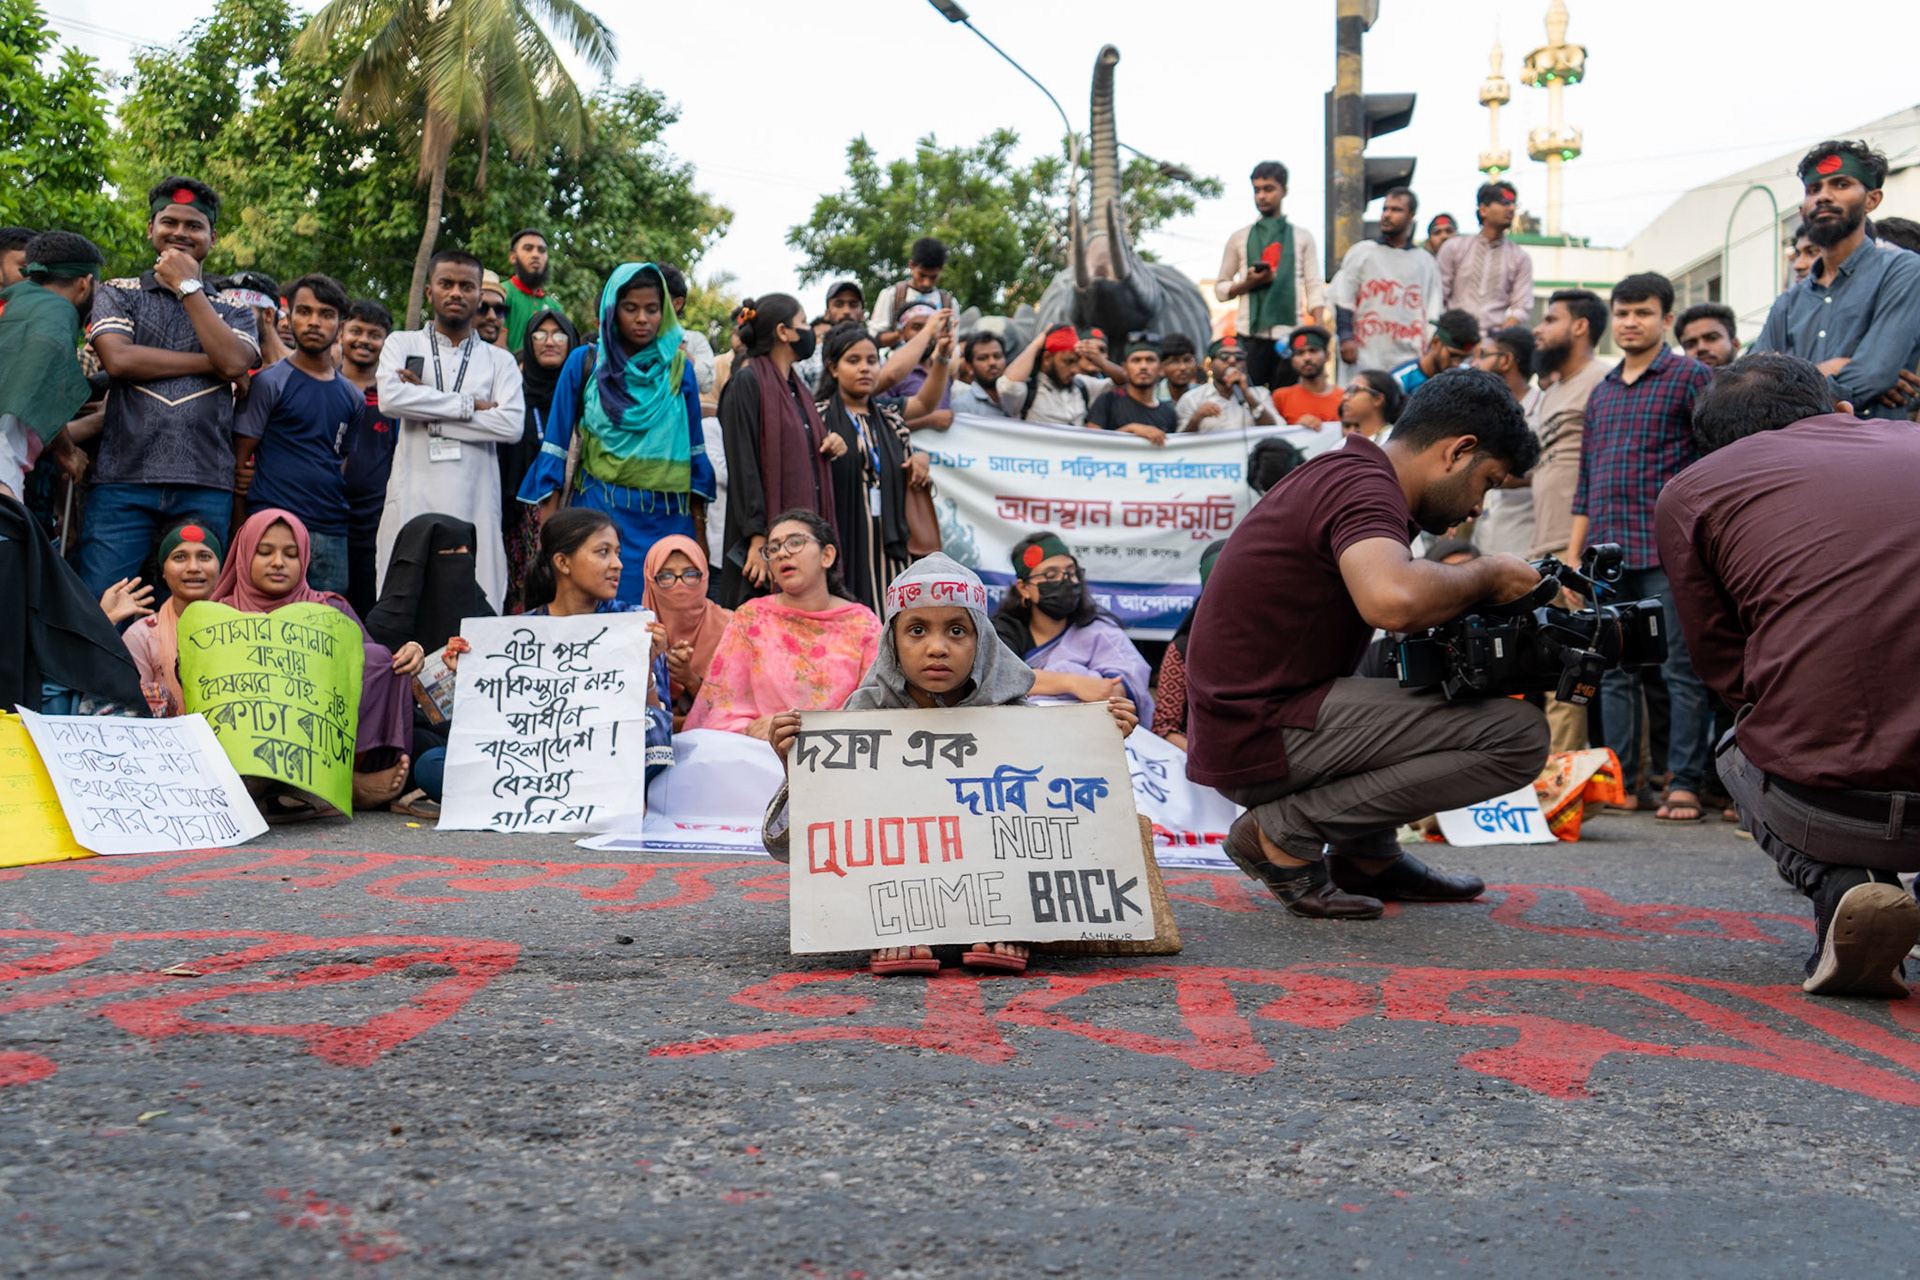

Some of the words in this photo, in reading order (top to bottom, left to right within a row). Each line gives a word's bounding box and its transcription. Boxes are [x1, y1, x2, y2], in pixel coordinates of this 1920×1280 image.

[925, 449, 977, 469] ০১৮
[988, 455, 1049, 479] সালের
[1061, 456, 1127, 481] পরিপত্র
[1138, 457, 1241, 484] পুনর্বহালের
[995, 494, 1112, 530] অবস্থান
[1121, 492, 1236, 540] কর্মসূচি
[898, 582, 923, 610] মুক্ত
[931, 581, 969, 602] দেশ
[1116, 593, 1195, 613] আন্দোলন
[189, 617, 272, 650] আমার
[279, 620, 340, 659] সোনার
[486, 627, 545, 668] এটা
[552, 626, 608, 672] পূর্ব
[246, 645, 311, 675] বাংলায়
[198, 672, 279, 701] বৈষম্যের
[474, 664, 580, 713] পাকিস্তান
[297, 707, 355, 771] বাতিল
[505, 697, 599, 740] স্বাধীন
[157, 750, 202, 775] নাম
[475, 727, 596, 773] বাংলাদেশ
[794, 728, 892, 773] দফা
[902, 730, 978, 770] এক
[492, 761, 584, 799] বৈষম্য
[946, 764, 1044, 816] দাবি
[1046, 776, 1109, 813] এক
[82, 806, 153, 835] এবার
[807, 815, 965, 878] QUOTA
[991, 815, 1079, 860] NOT
[868, 870, 1012, 937] COME
[1027, 868, 1144, 924] BACK
[1080, 931, 1134, 941] ASHIKUR
